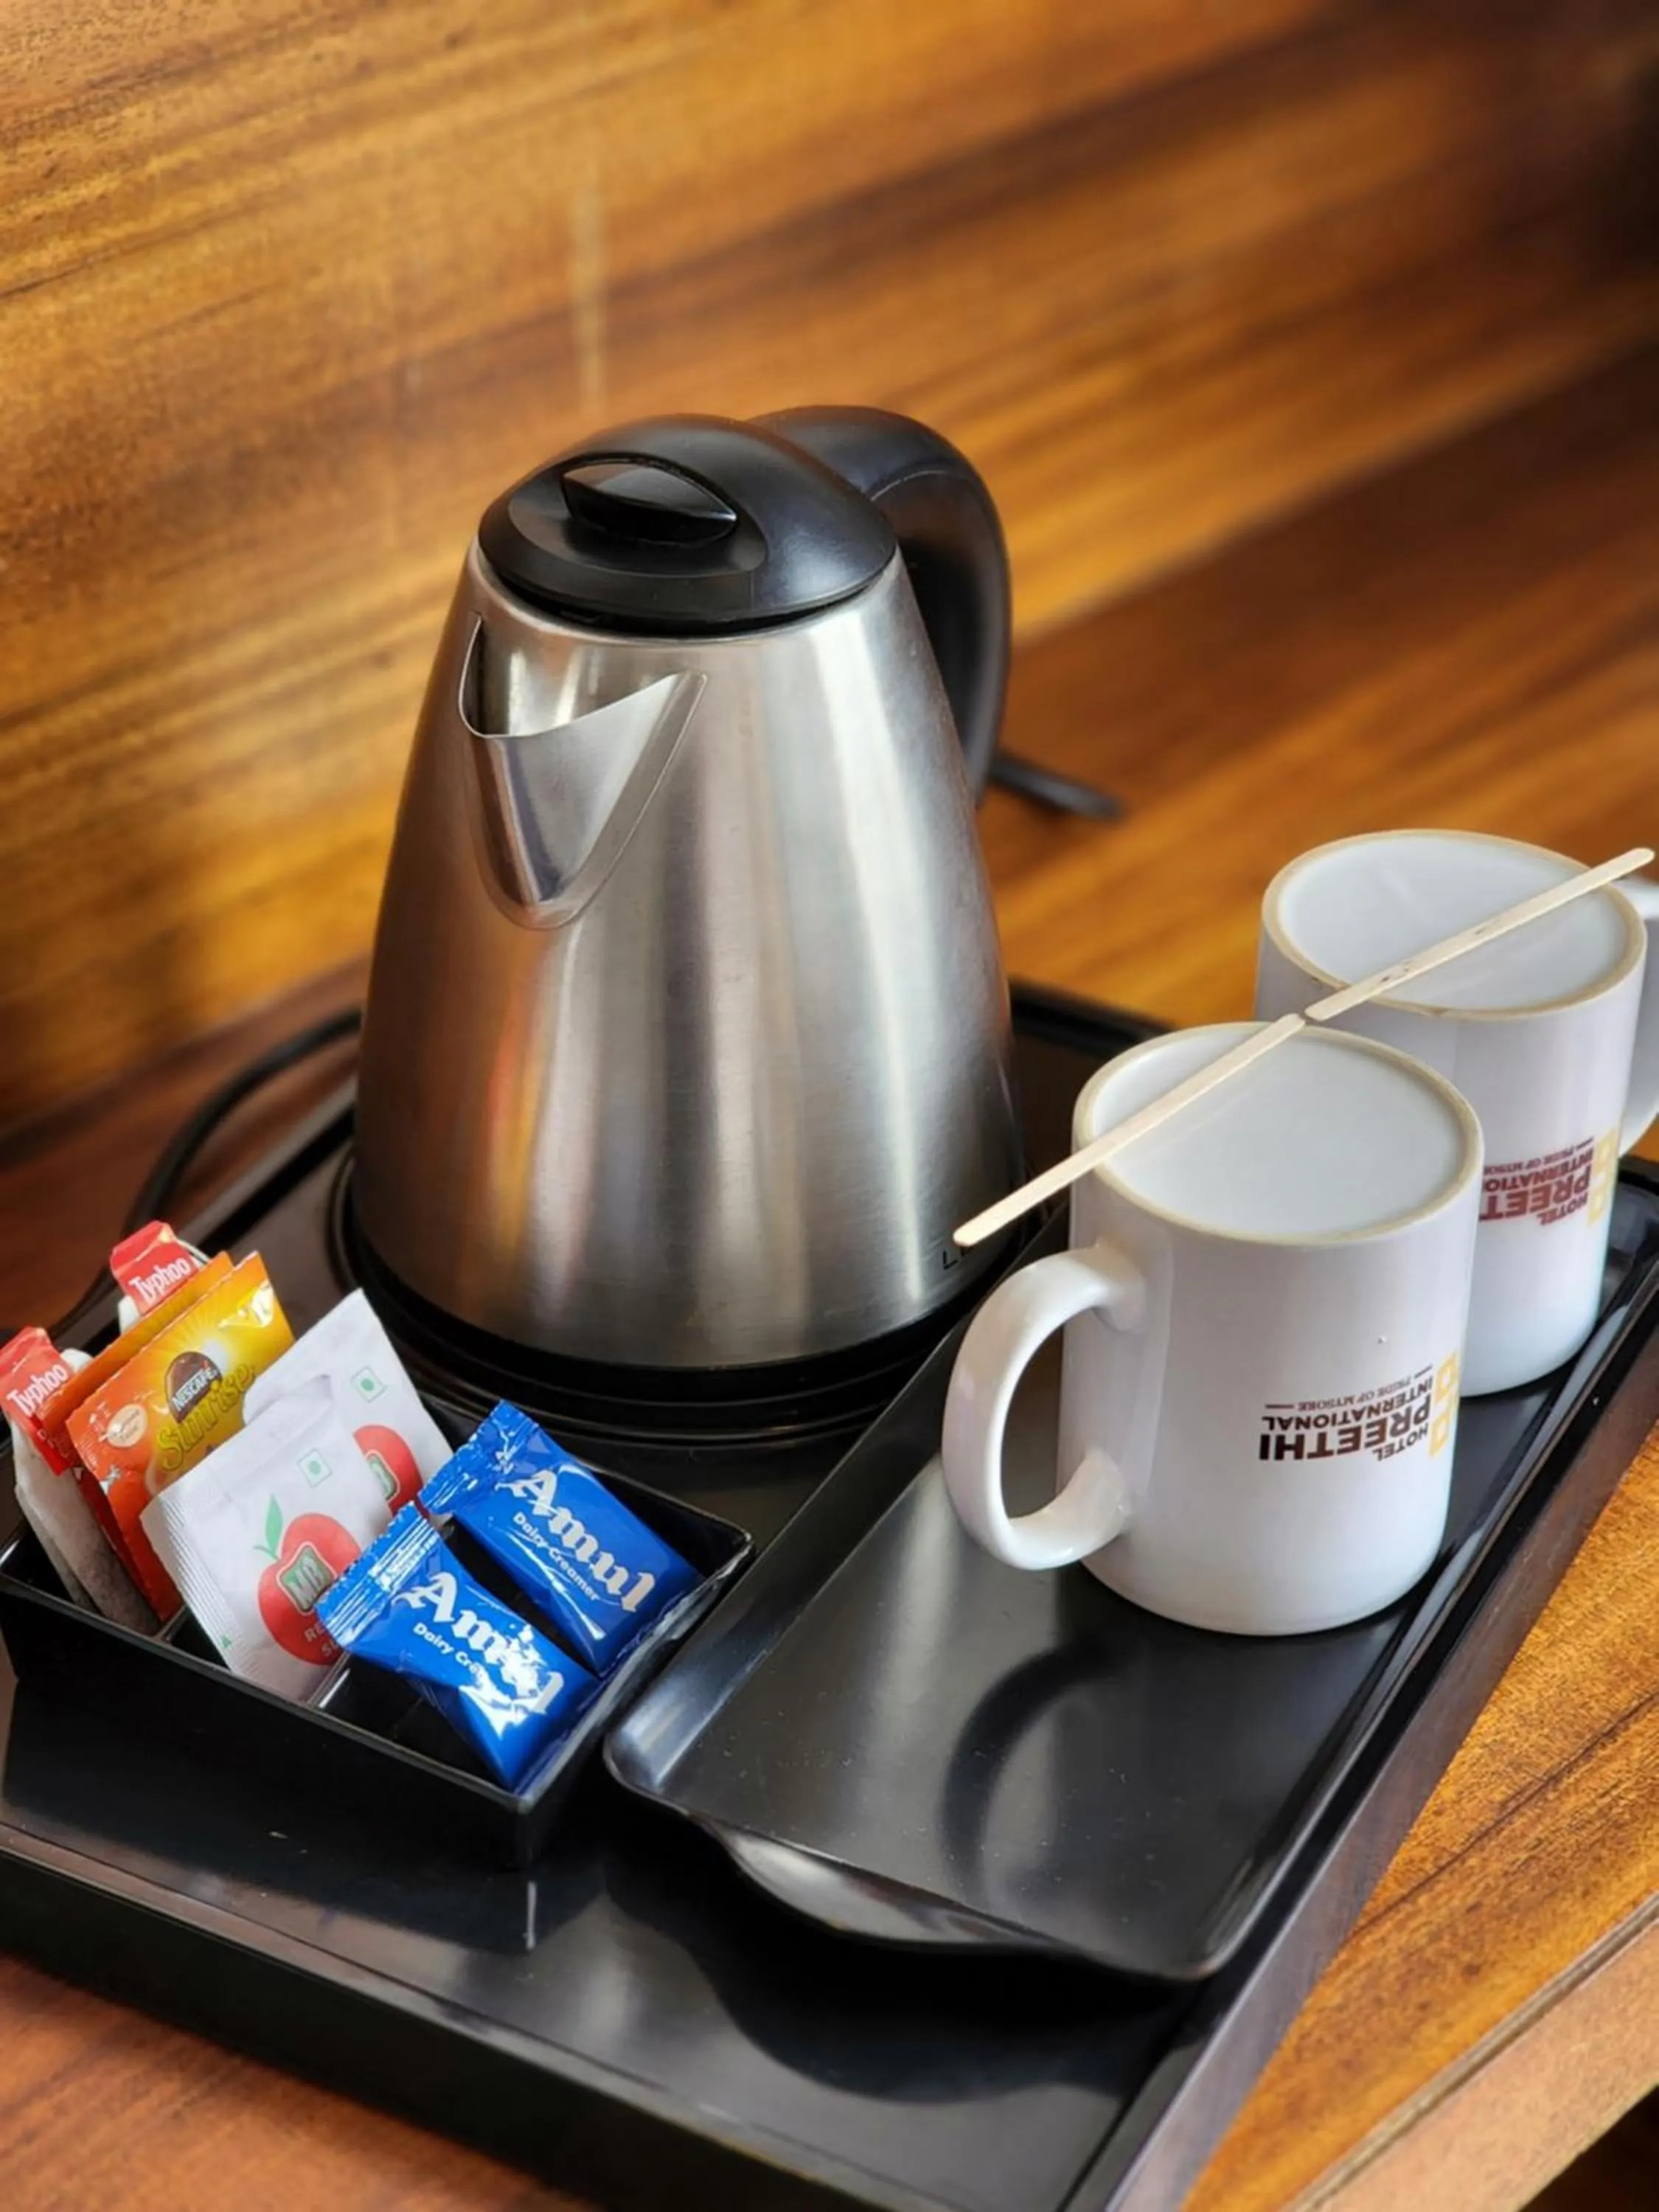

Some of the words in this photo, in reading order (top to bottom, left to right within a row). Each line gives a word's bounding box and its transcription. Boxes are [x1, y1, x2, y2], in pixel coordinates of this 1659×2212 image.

[1483, 1148, 1593, 1192] INTERNATIO
[1537, 1192, 1589, 1225] HOTEL
[128, 1256, 192, 1303] Typhoo
[7, 1363, 69, 1416] Typhoo
[1262, 1376, 1433, 1431] INTERNATIONAL
[1298, 1394, 1354, 1411] MYSORE
[1357, 1390, 1375, 1402] OF
[158, 1365, 254, 1472] Sunrise
[1259, 1394, 1431, 1461] PREETHI
[1372, 1422, 1429, 1461] HOTEL
[495, 1470, 655, 1613] Amul
[513, 1512, 549, 1552] Dairy
[549, 1548, 599, 1601] Creamer
[413, 1622, 454, 1655] Dairy
